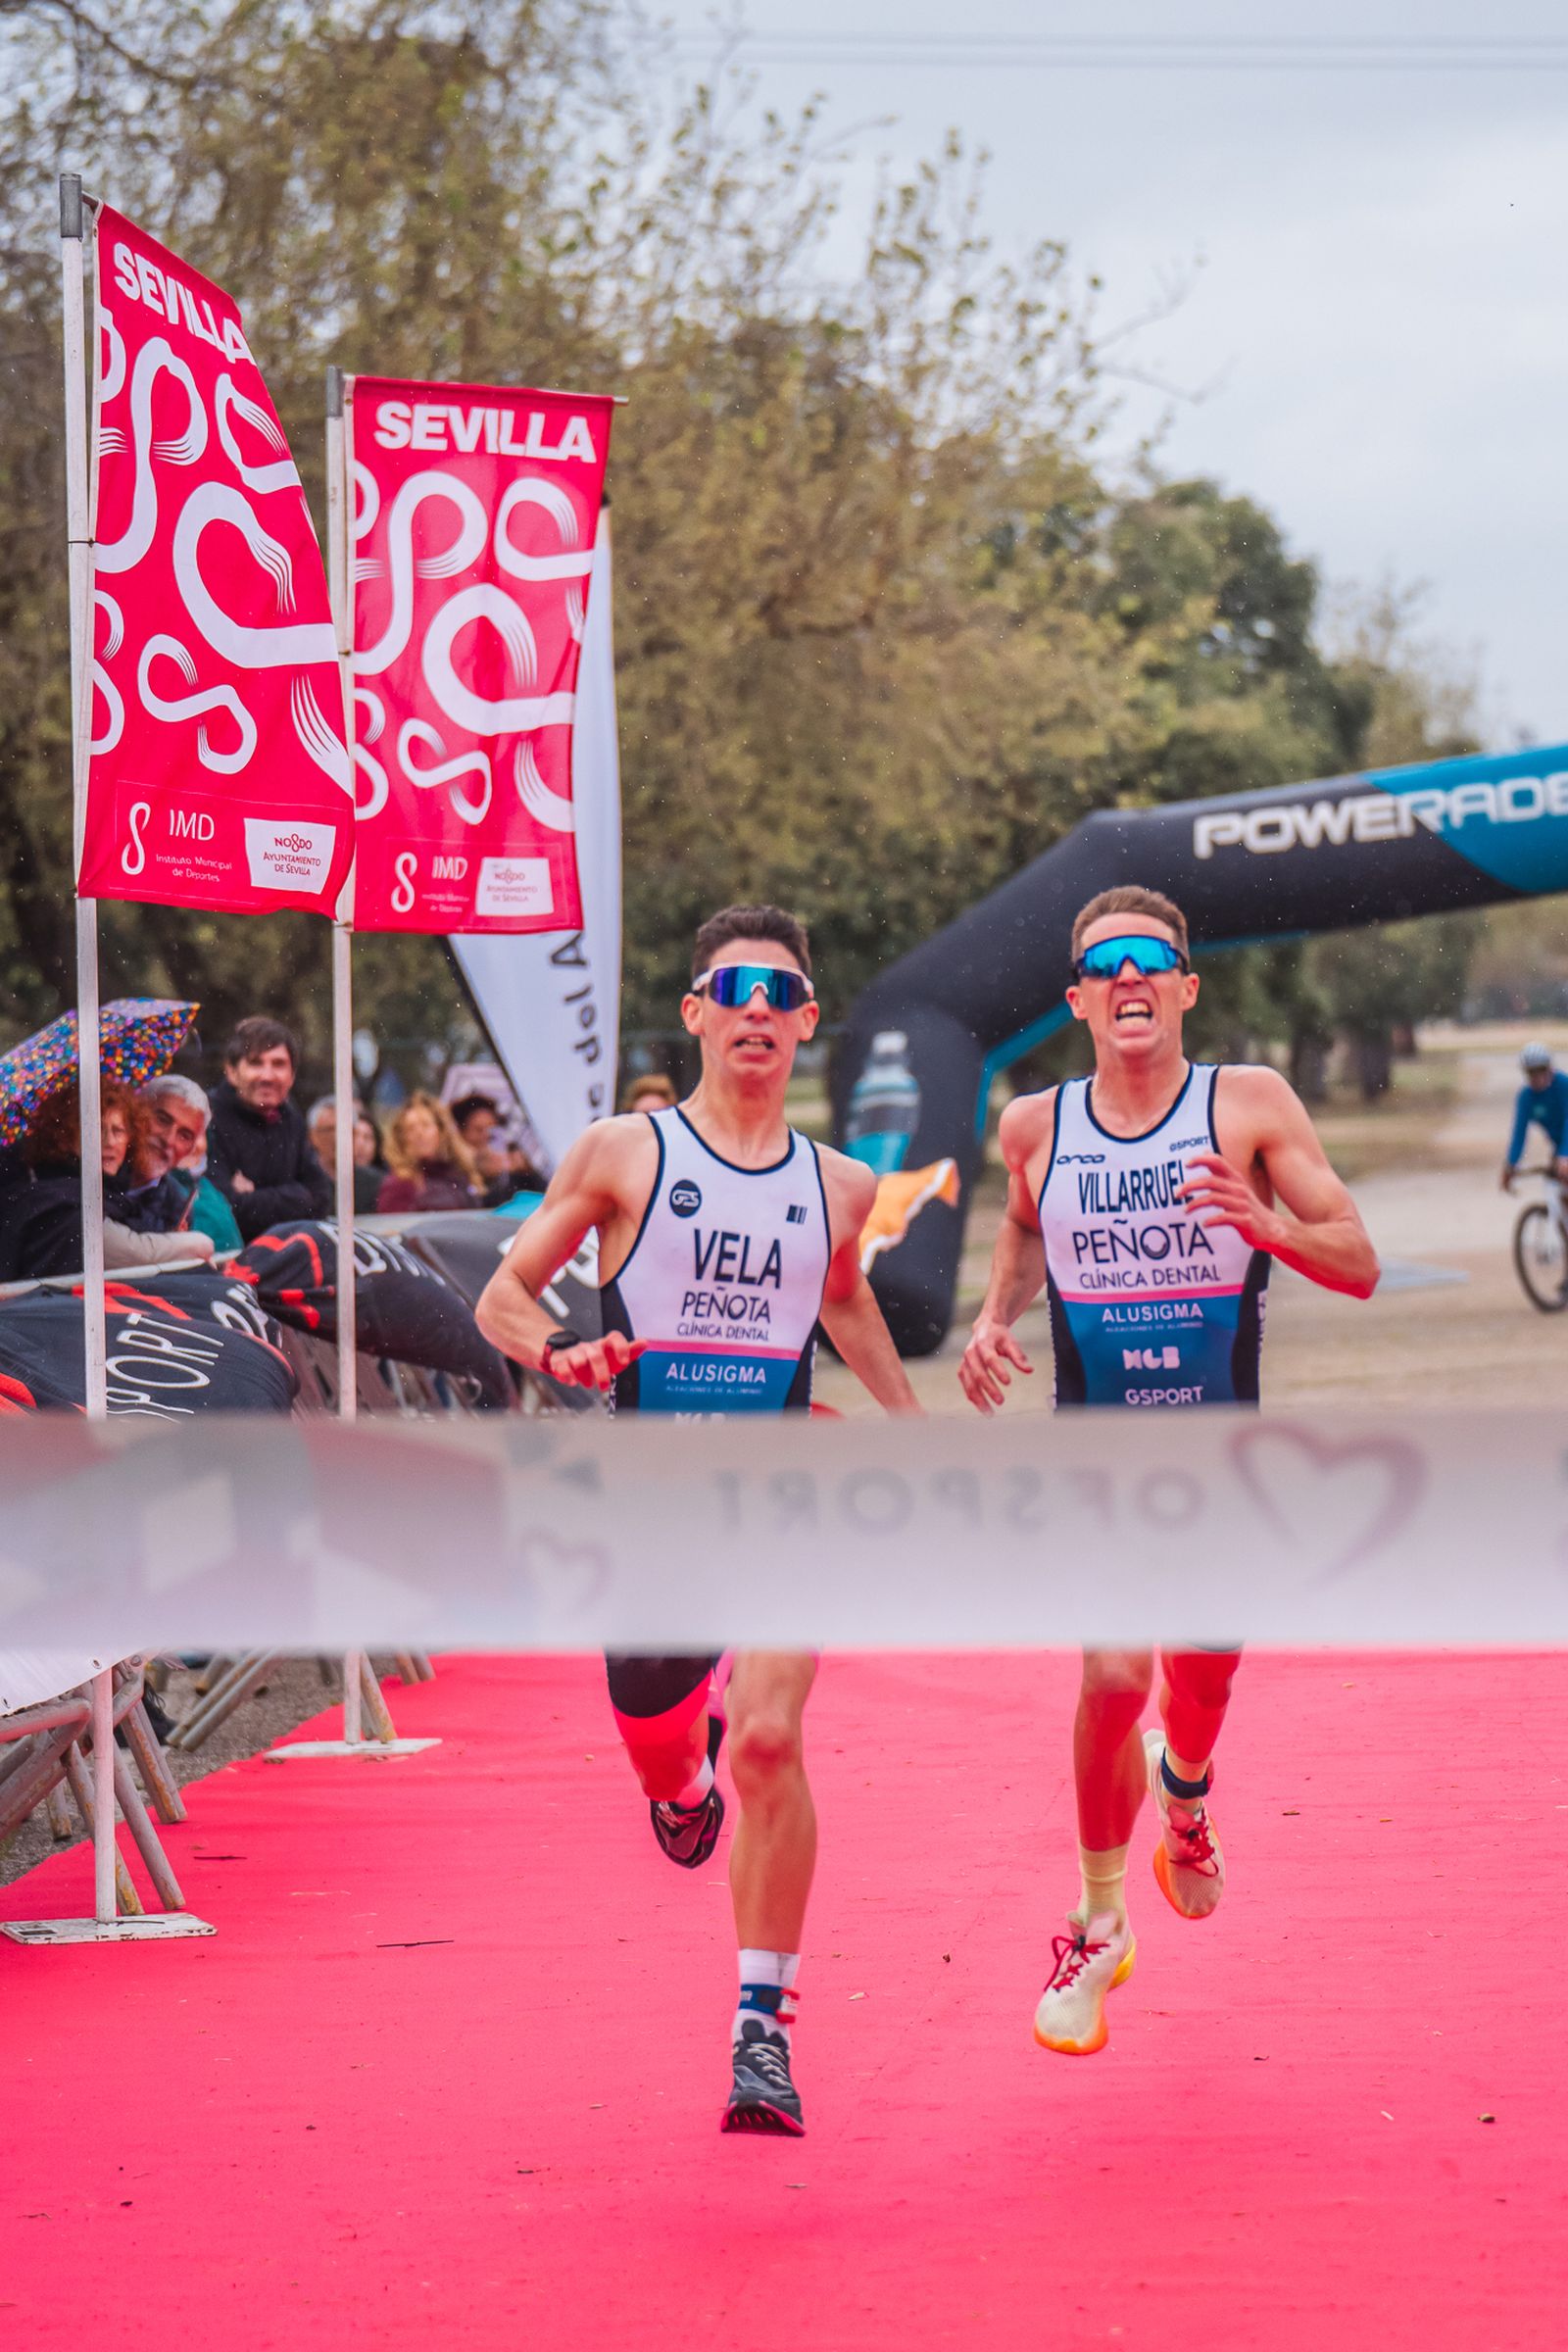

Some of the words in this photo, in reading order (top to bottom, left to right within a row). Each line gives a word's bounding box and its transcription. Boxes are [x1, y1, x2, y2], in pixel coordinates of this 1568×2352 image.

[113, 241, 258, 367] SEVILLA
[373, 401, 597, 464] SEVILLA
[169, 808, 215, 842] IMD
[263, 852, 321, 867] AYUNTAMIENTO
[274, 863, 284, 873] DE
[285, 863, 312, 876] SEVILLA
[431, 856, 468, 882] IMD
[1078, 1159, 1195, 1215] VILLARRUEL
[1071, 1218, 1215, 1265] PEÑOTA
[694, 1227, 783, 1290] VELA
[1079, 1269, 1149, 1290] CLÍNICA
[1152, 1264, 1222, 1287] DENTAL
[680, 1285, 772, 1324] PEÑOTA
[1102, 1302, 1204, 1324] ALUSIGMA
[676, 1321, 723, 1339] CLÍNICA
[725, 1324, 770, 1342] DENTAL
[106, 1312, 224, 1423] PORT
[665, 1361, 767, 1384] ALUSIGMA
[1124, 1385, 1204, 1406] GSPORT
